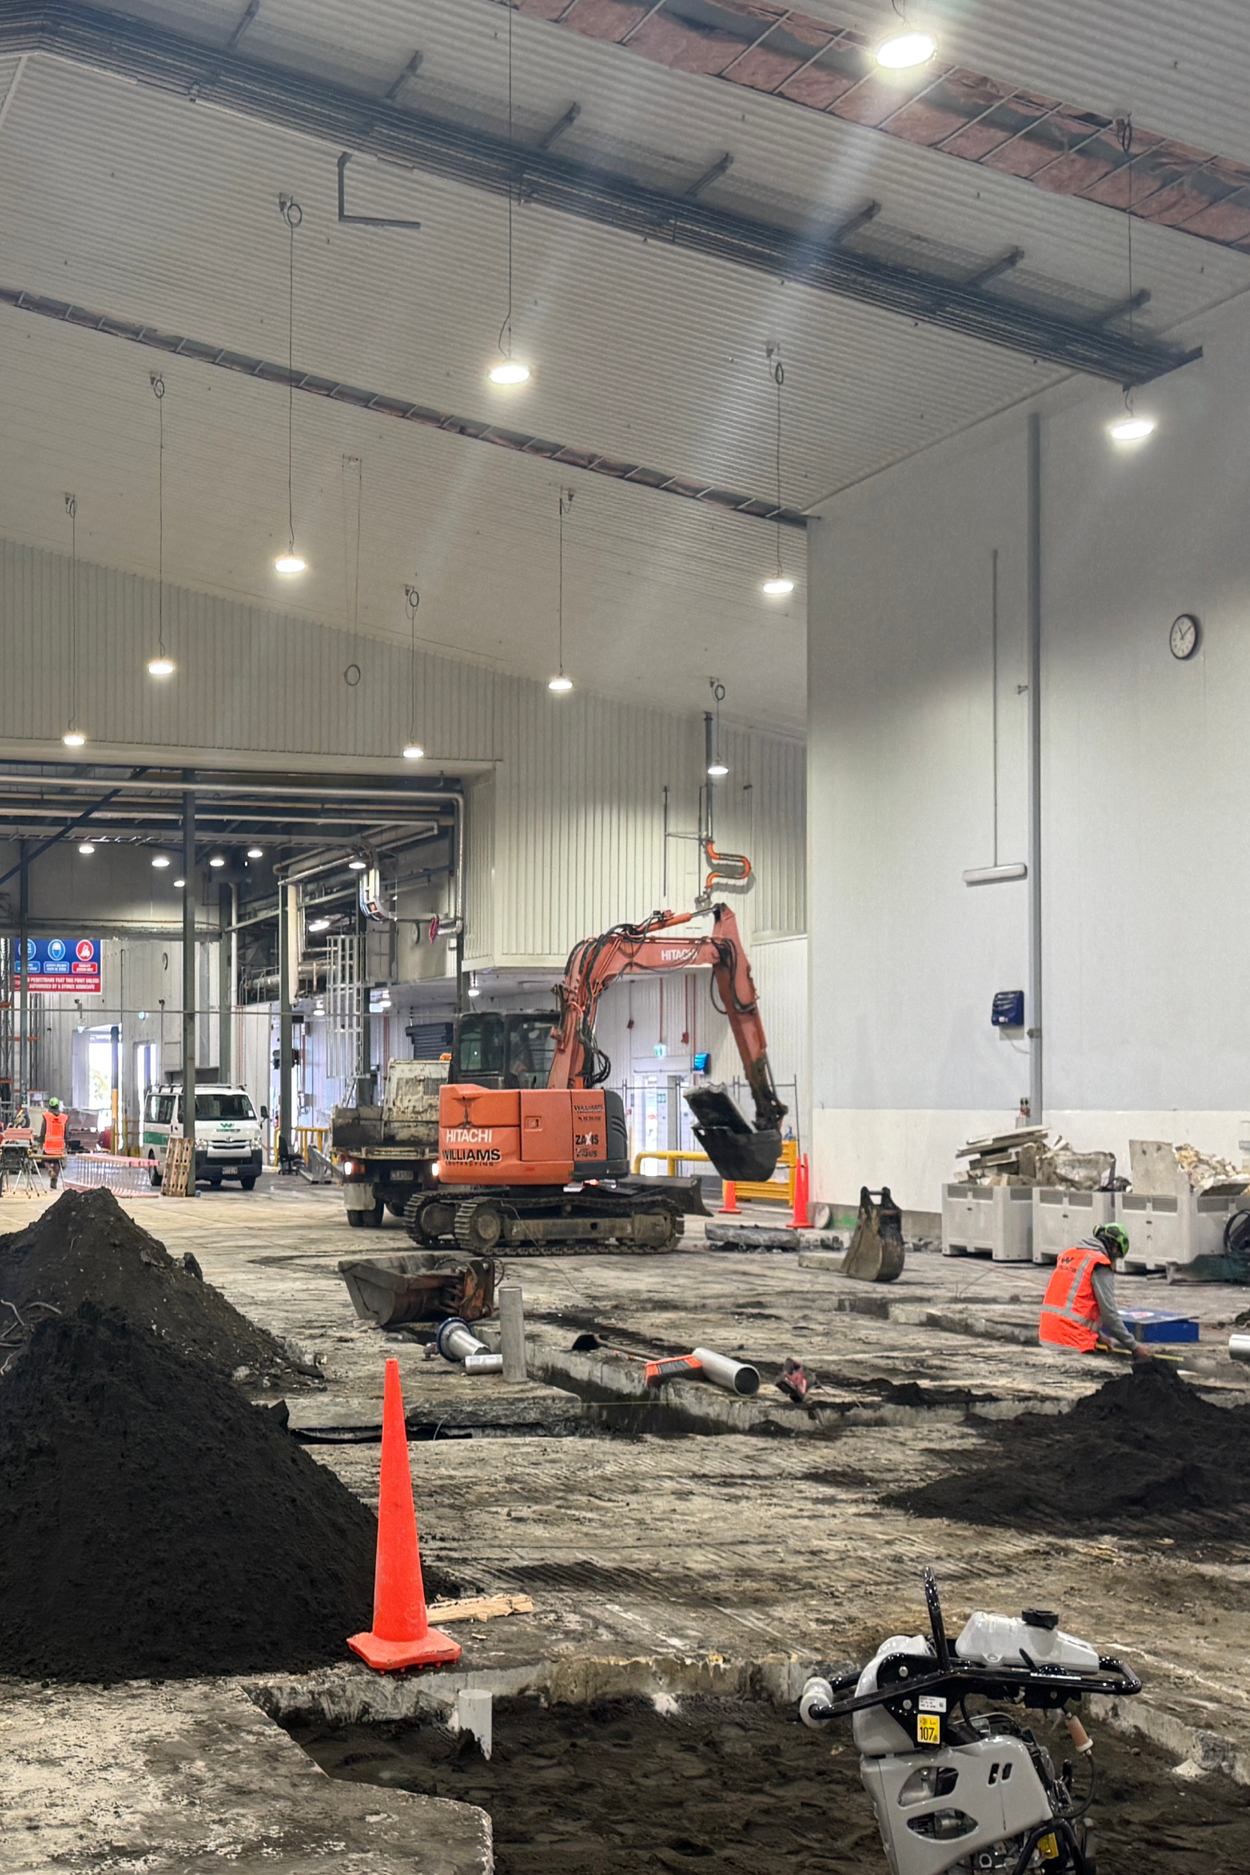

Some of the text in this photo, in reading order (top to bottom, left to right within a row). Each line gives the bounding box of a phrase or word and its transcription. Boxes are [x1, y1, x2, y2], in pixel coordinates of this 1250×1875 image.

[446, 1129, 492, 1143] HITACHI
[575, 1132, 599, 1146] ZAXIS
[442, 1149, 501, 1161] WILLIAMS
[920, 1726, 935, 1741] 107
